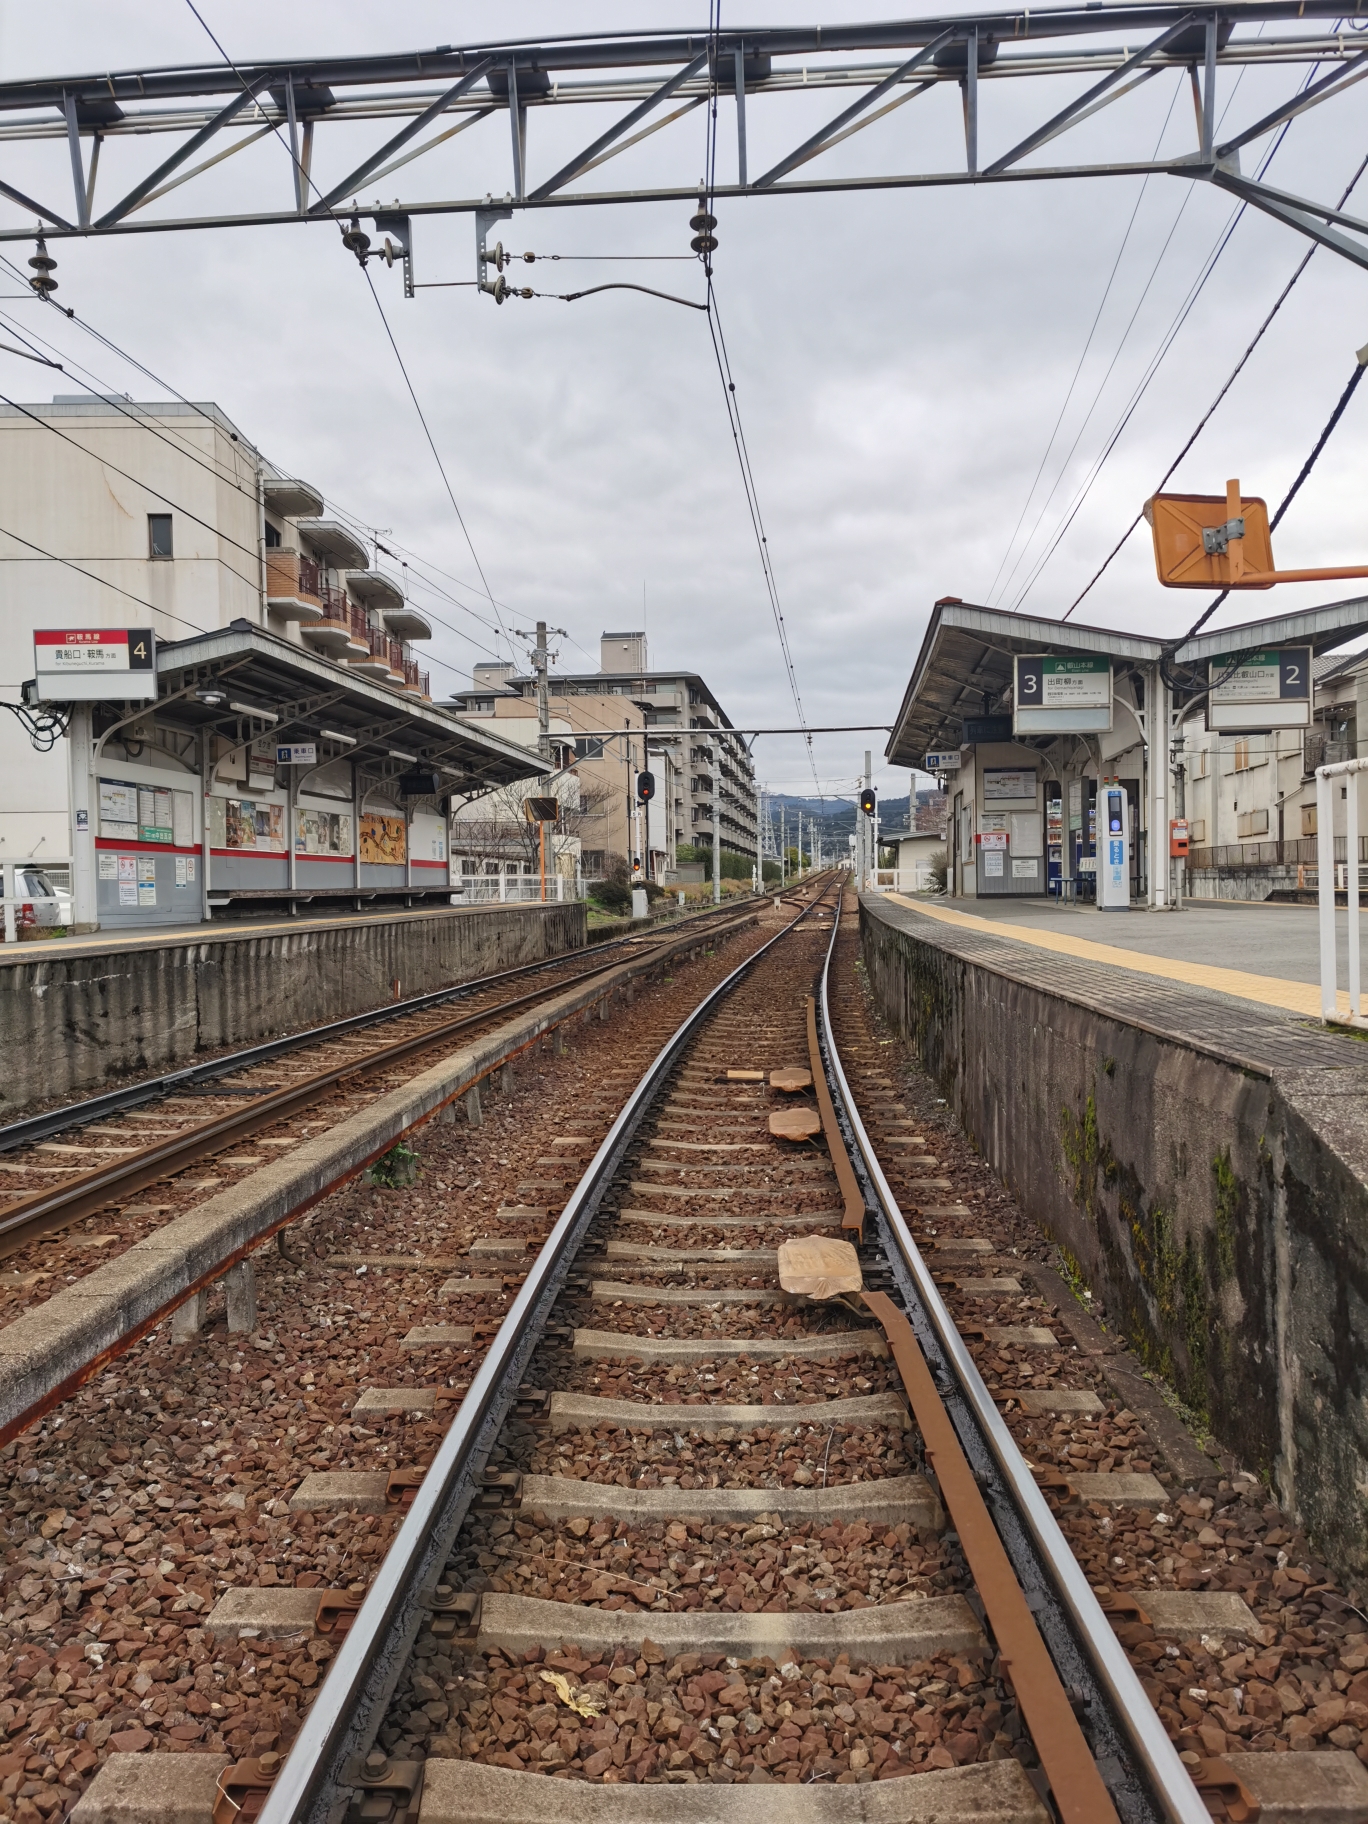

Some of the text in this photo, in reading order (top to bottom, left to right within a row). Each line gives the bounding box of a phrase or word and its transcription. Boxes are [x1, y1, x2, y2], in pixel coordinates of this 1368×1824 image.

[134, 642, 146, 659] 4
[1024, 675, 1037, 693] 3
[1285, 665, 1301, 685] 2
